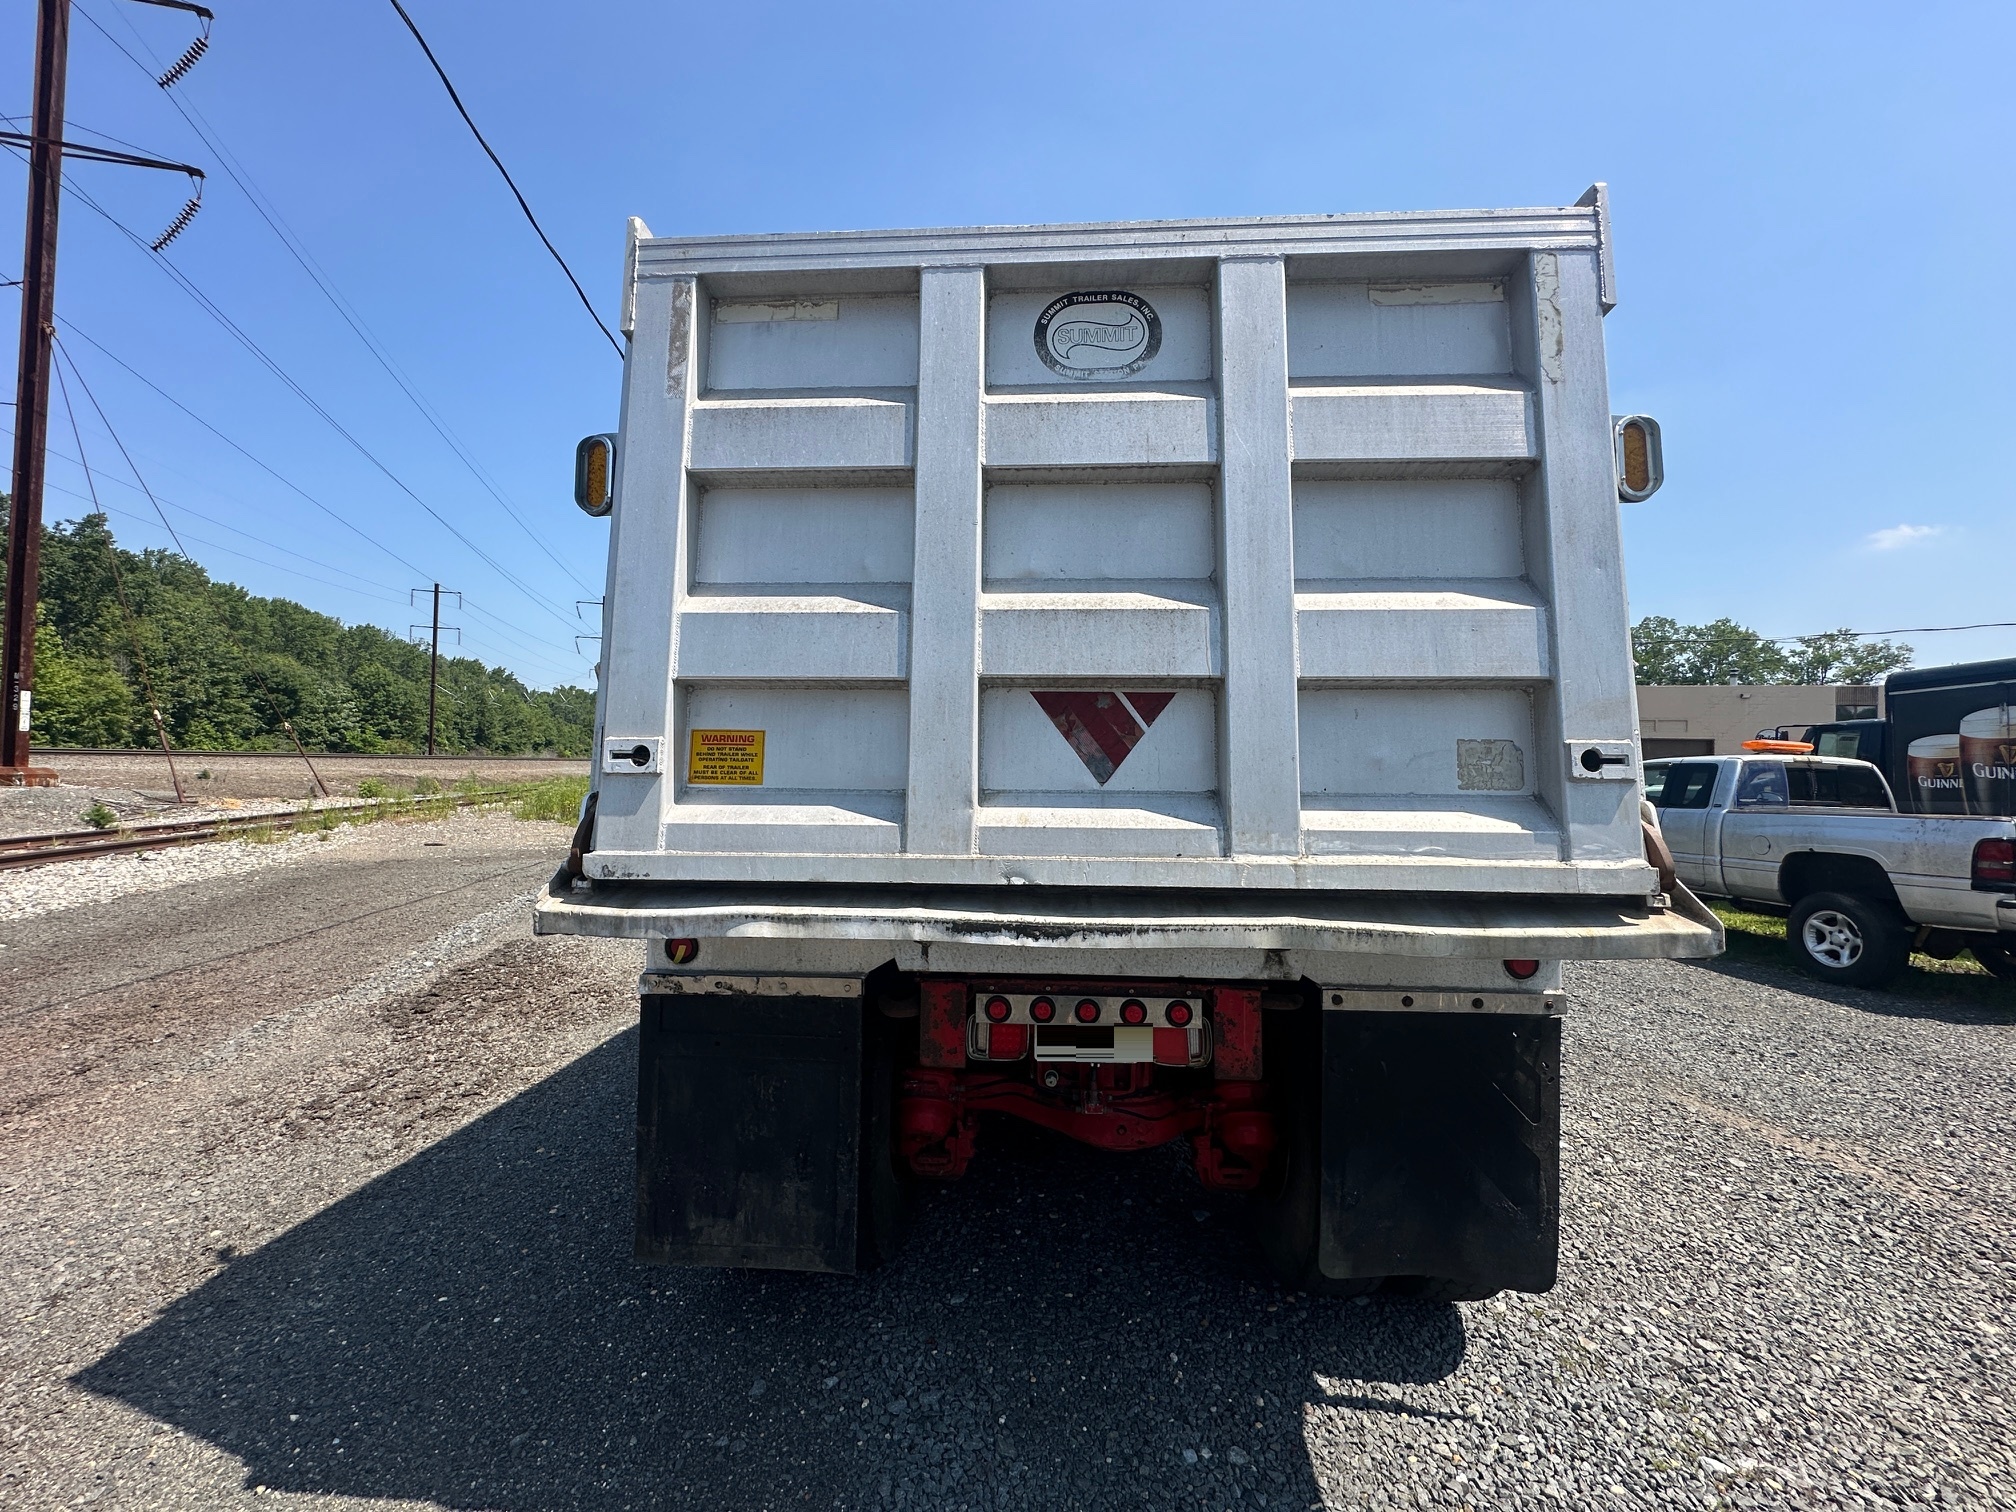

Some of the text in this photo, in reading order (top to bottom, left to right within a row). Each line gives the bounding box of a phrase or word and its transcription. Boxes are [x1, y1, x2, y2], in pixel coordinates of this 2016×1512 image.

[1041, 299, 1068, 325] SUMMIT
[1072, 294, 1108, 304] TRAILER
[1111, 294, 1140, 308] SALES,
[1057, 326, 1138, 345] SUMMIT
[701, 734, 755, 743] WARNING
[1972, 762, 2016, 780] GUIN
